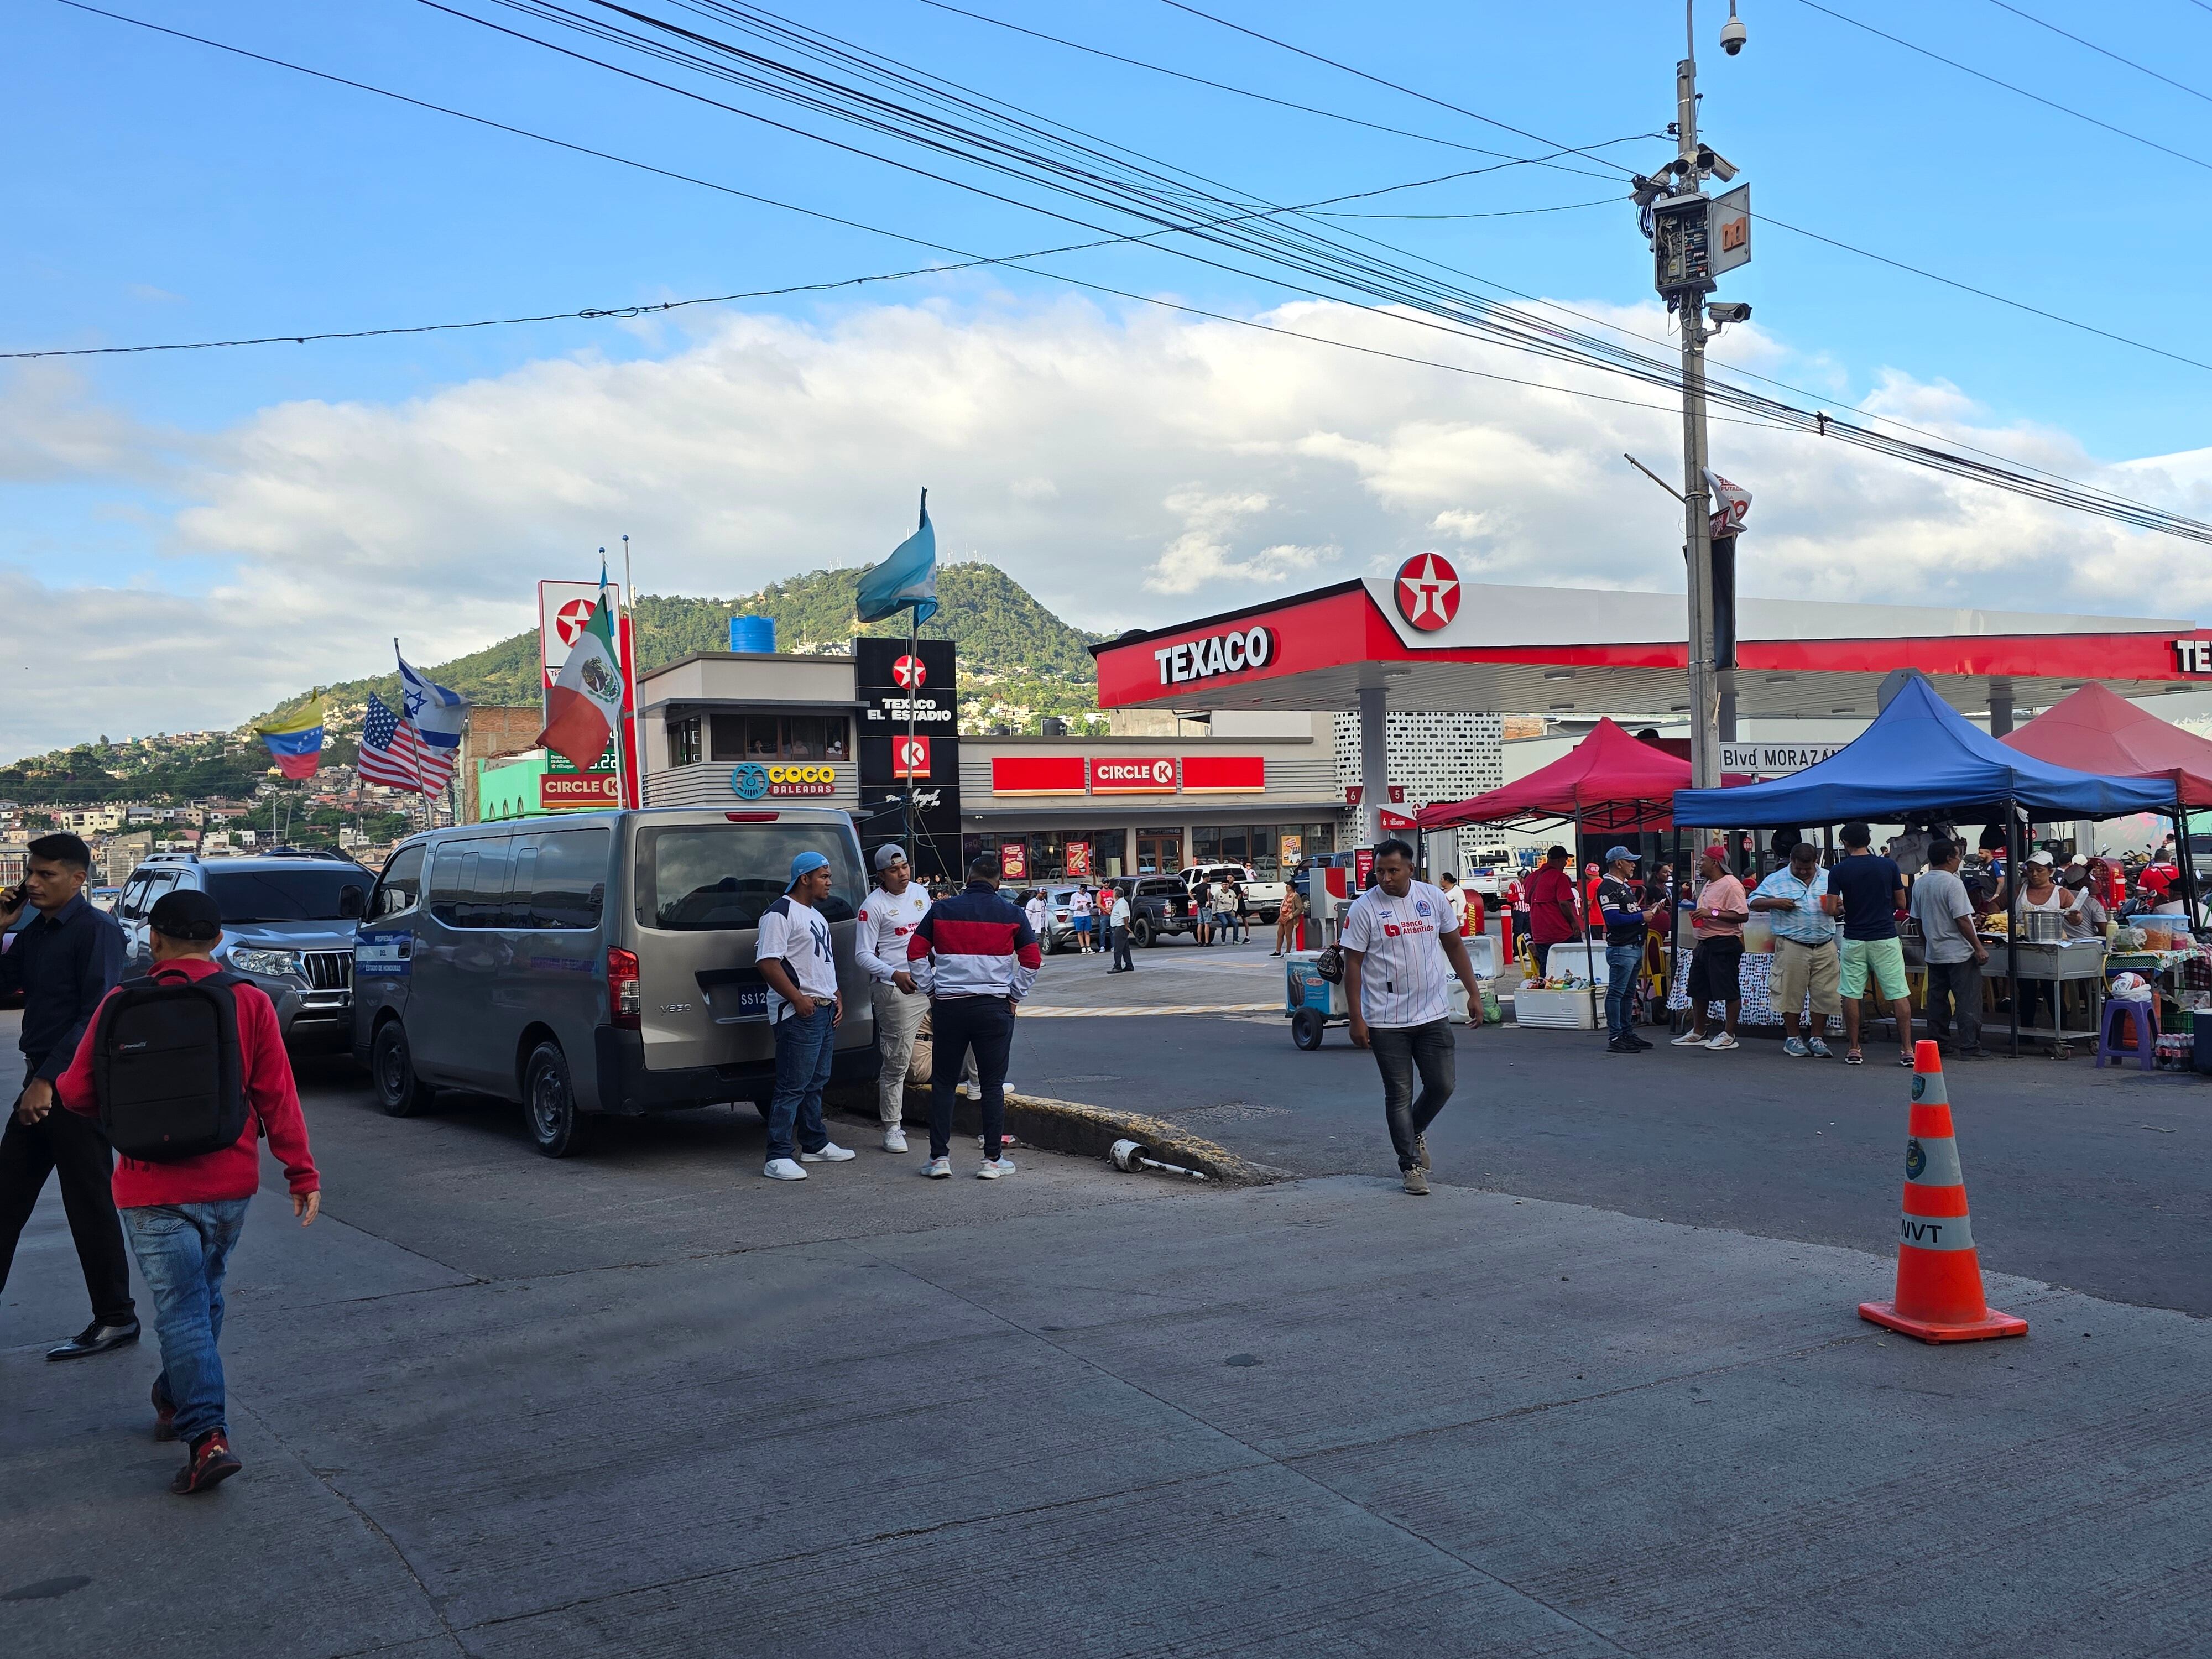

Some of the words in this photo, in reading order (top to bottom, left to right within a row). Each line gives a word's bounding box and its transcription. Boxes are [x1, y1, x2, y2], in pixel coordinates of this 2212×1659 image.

[1155, 625, 1272, 685] TEXACO
[2177, 639, 2212, 672] TE
[867, 709, 885, 720] EL
[1723, 748, 1757, 766] Blvd
[768, 765, 836, 784] COCO
[1097, 765, 1150, 779] CIRCLE
[545, 781, 599, 793] CIRCLE
[773, 785, 832, 794] BALEADAS
[1350, 791, 1356, 800] 6
[1395, 790, 1400, 799] 5
[1383, 817, 1387, 826] 6
[1401, 920, 1423, 928] Banco
[1467, 902, 1476, 937] avoline
[1402, 925, 1434, 935] Atlántida
[741, 992, 766, 1005] SS12
[1901, 1218, 1943, 1243] NVT
